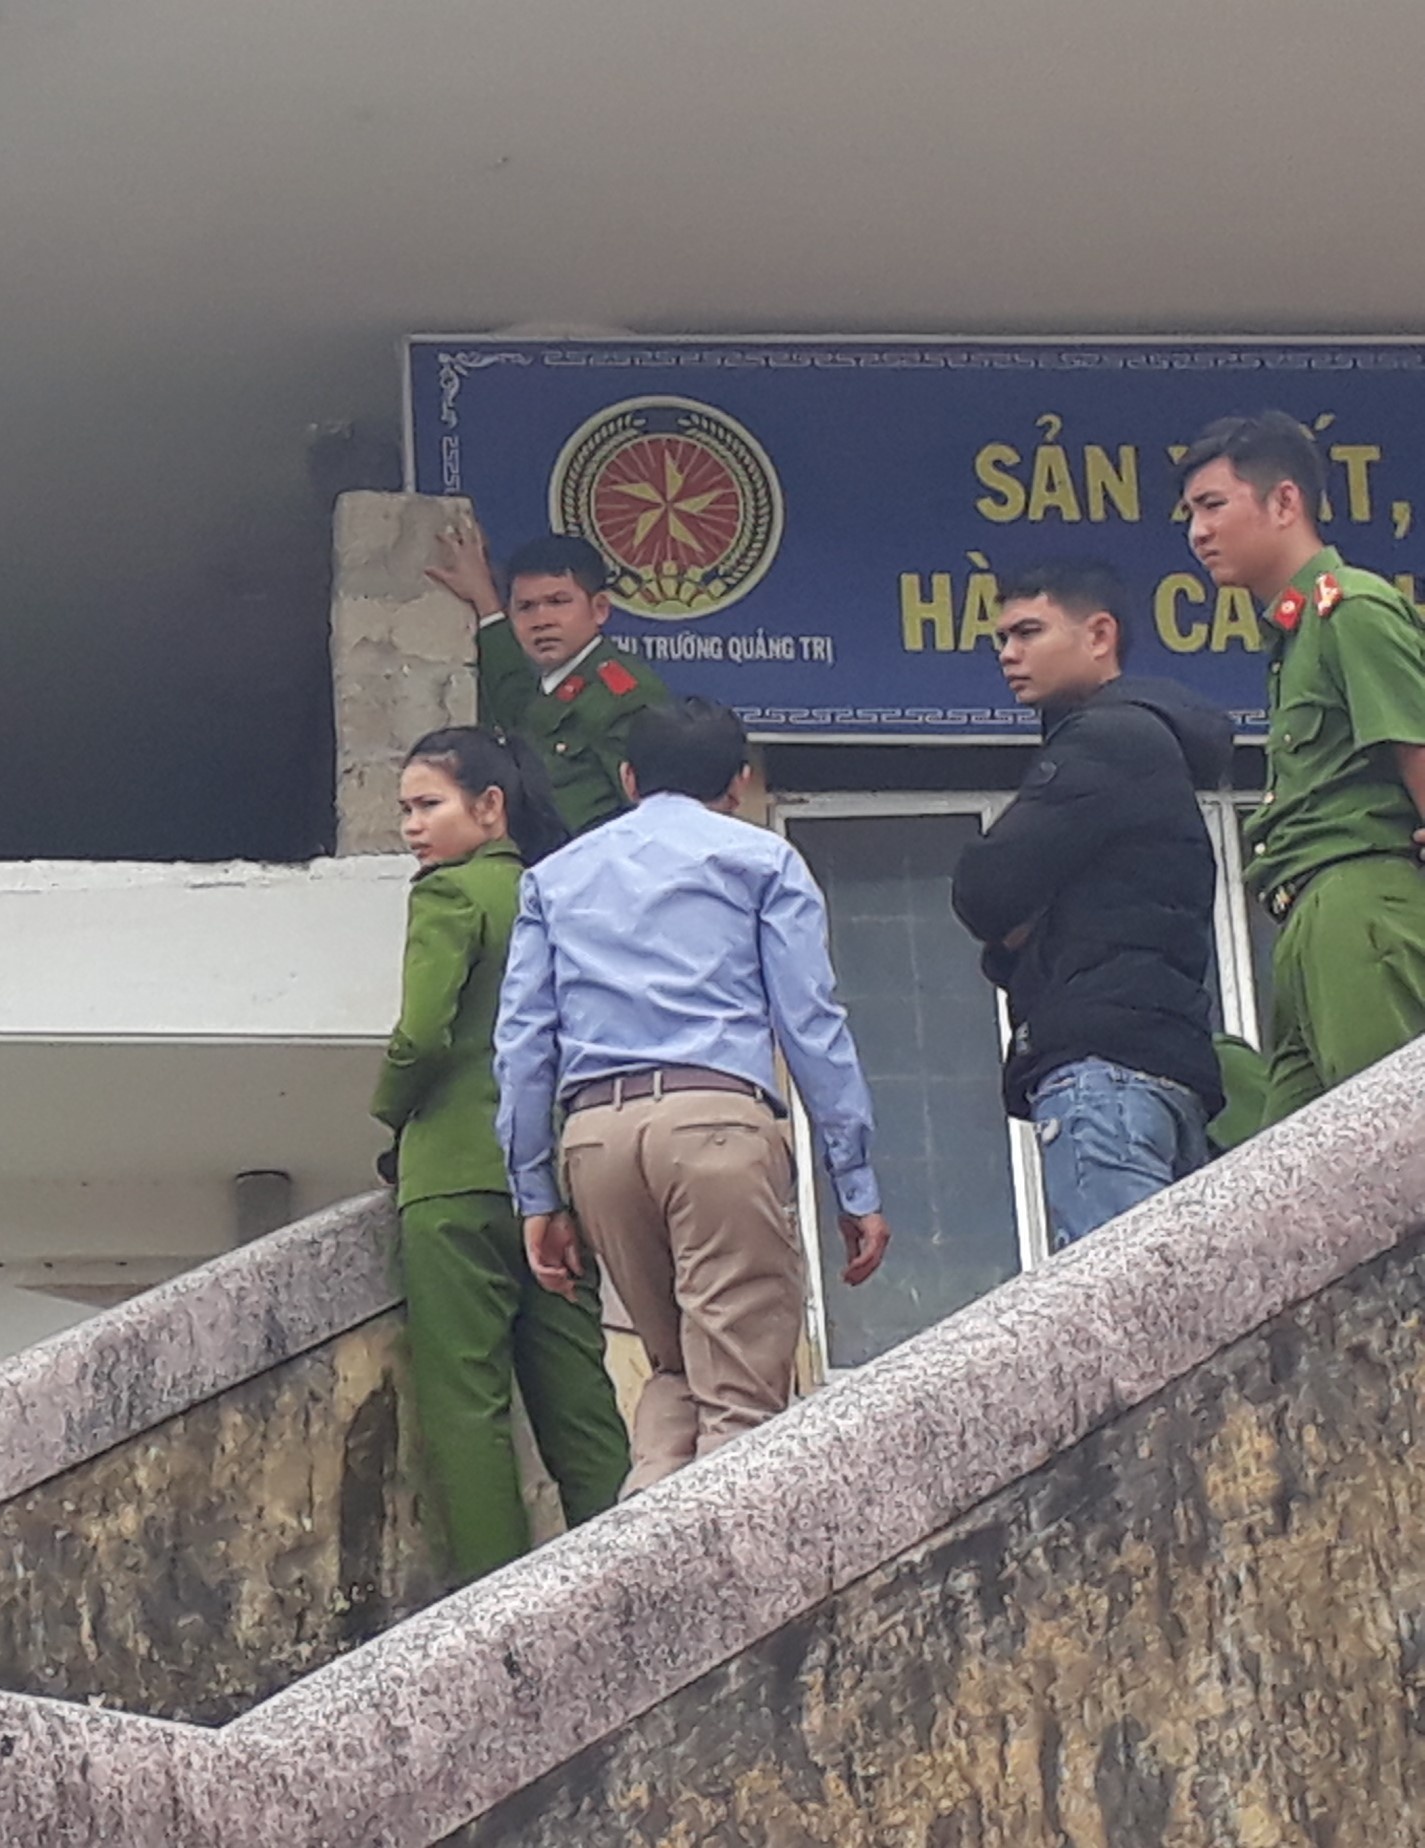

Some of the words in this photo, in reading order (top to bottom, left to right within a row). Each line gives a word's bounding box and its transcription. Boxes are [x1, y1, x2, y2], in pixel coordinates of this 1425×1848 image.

[976, 414, 1140, 522] SẢN
[728, 628, 796, 663] QUẢNG
[799, 636, 834, 664] TRỊ
